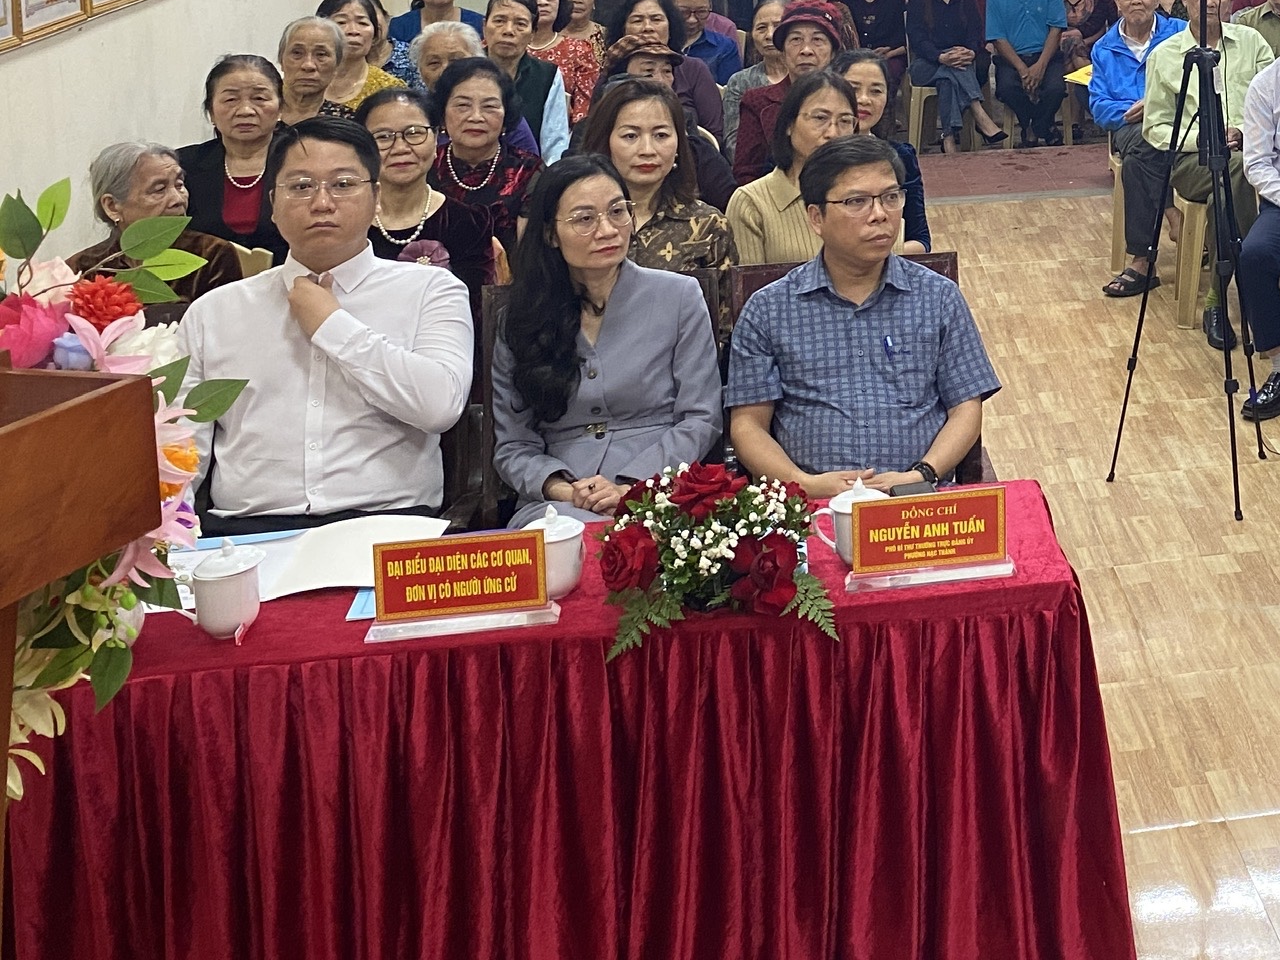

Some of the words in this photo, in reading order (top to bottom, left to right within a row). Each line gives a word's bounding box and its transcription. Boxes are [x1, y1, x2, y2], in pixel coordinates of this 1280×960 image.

[901, 506, 934, 520] ĐỒNG
[937, 503, 957, 516] CHÍ
[869, 522, 920, 543] NGUYỄN
[923, 522, 949, 538] ANH
[953, 515, 985, 534] TUẤN
[387, 561, 403, 580] ĐẠI
[405, 552, 426, 574] BIỂU
[428, 557, 444, 576] ĐẠI
[447, 552, 468, 573] DIỆN
[470, 550, 488, 569] CÁC
[490, 549, 503, 567] CƠ
[505, 548, 532, 567] QUAN,
[406, 584, 425, 602] ĐƠN
[427, 584, 436, 603] VỊ
[439, 579, 451, 599] CÓ
[453, 578, 481, 597] NGƯỜI
[484, 575, 502, 594] ỨNG
[504, 571, 517, 592] CỬ
